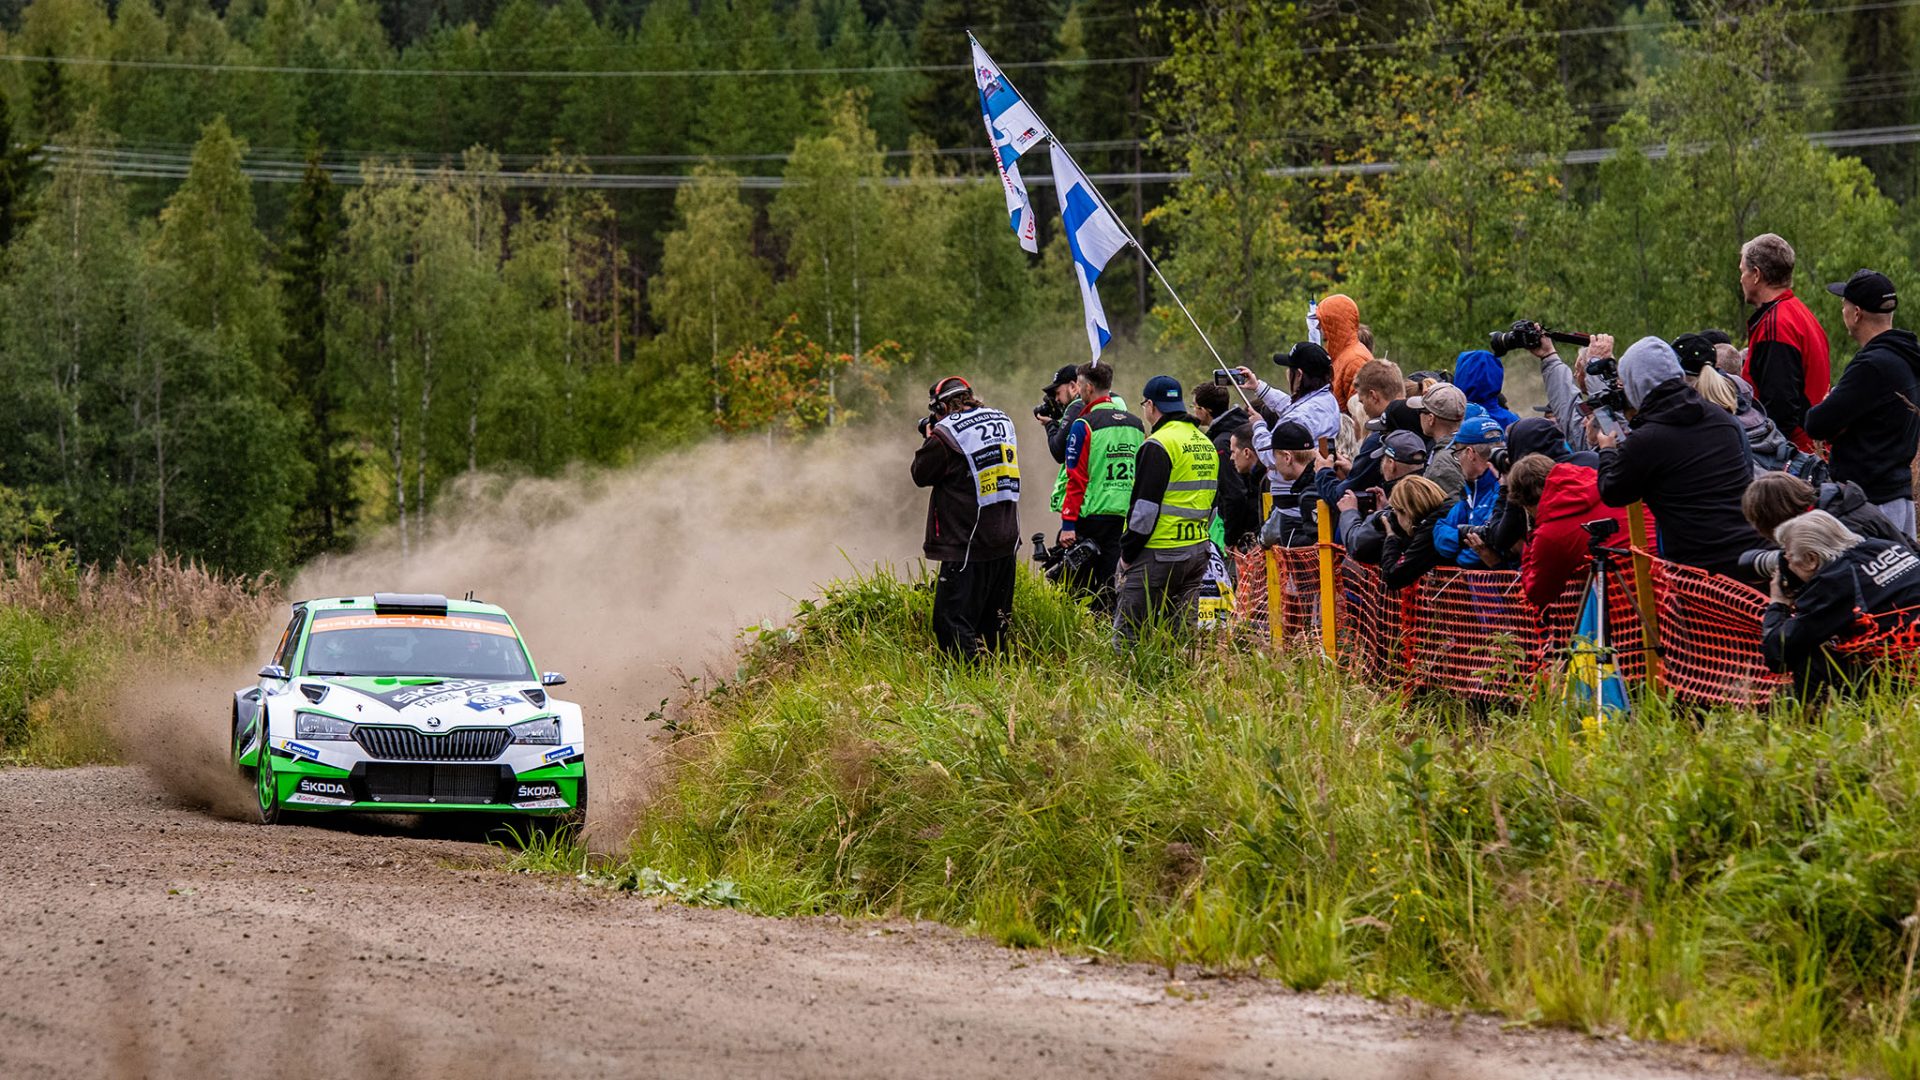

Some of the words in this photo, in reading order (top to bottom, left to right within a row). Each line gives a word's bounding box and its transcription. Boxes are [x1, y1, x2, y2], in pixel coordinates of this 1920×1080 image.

[975, 422, 1006, 441] 220
[1106, 443, 1136, 453] WRC
[981, 483, 997, 493] 201
[1861, 545, 1911, 576] WRC
[1198, 611, 1214, 619] 019
[422, 618, 448, 626] ALL
[451, 620, 481, 629] LIVE
[292, 745, 317, 757] MICHELIN
[301, 779, 346, 794] ŠKODA
[518, 785, 556, 797] ŠKODA
